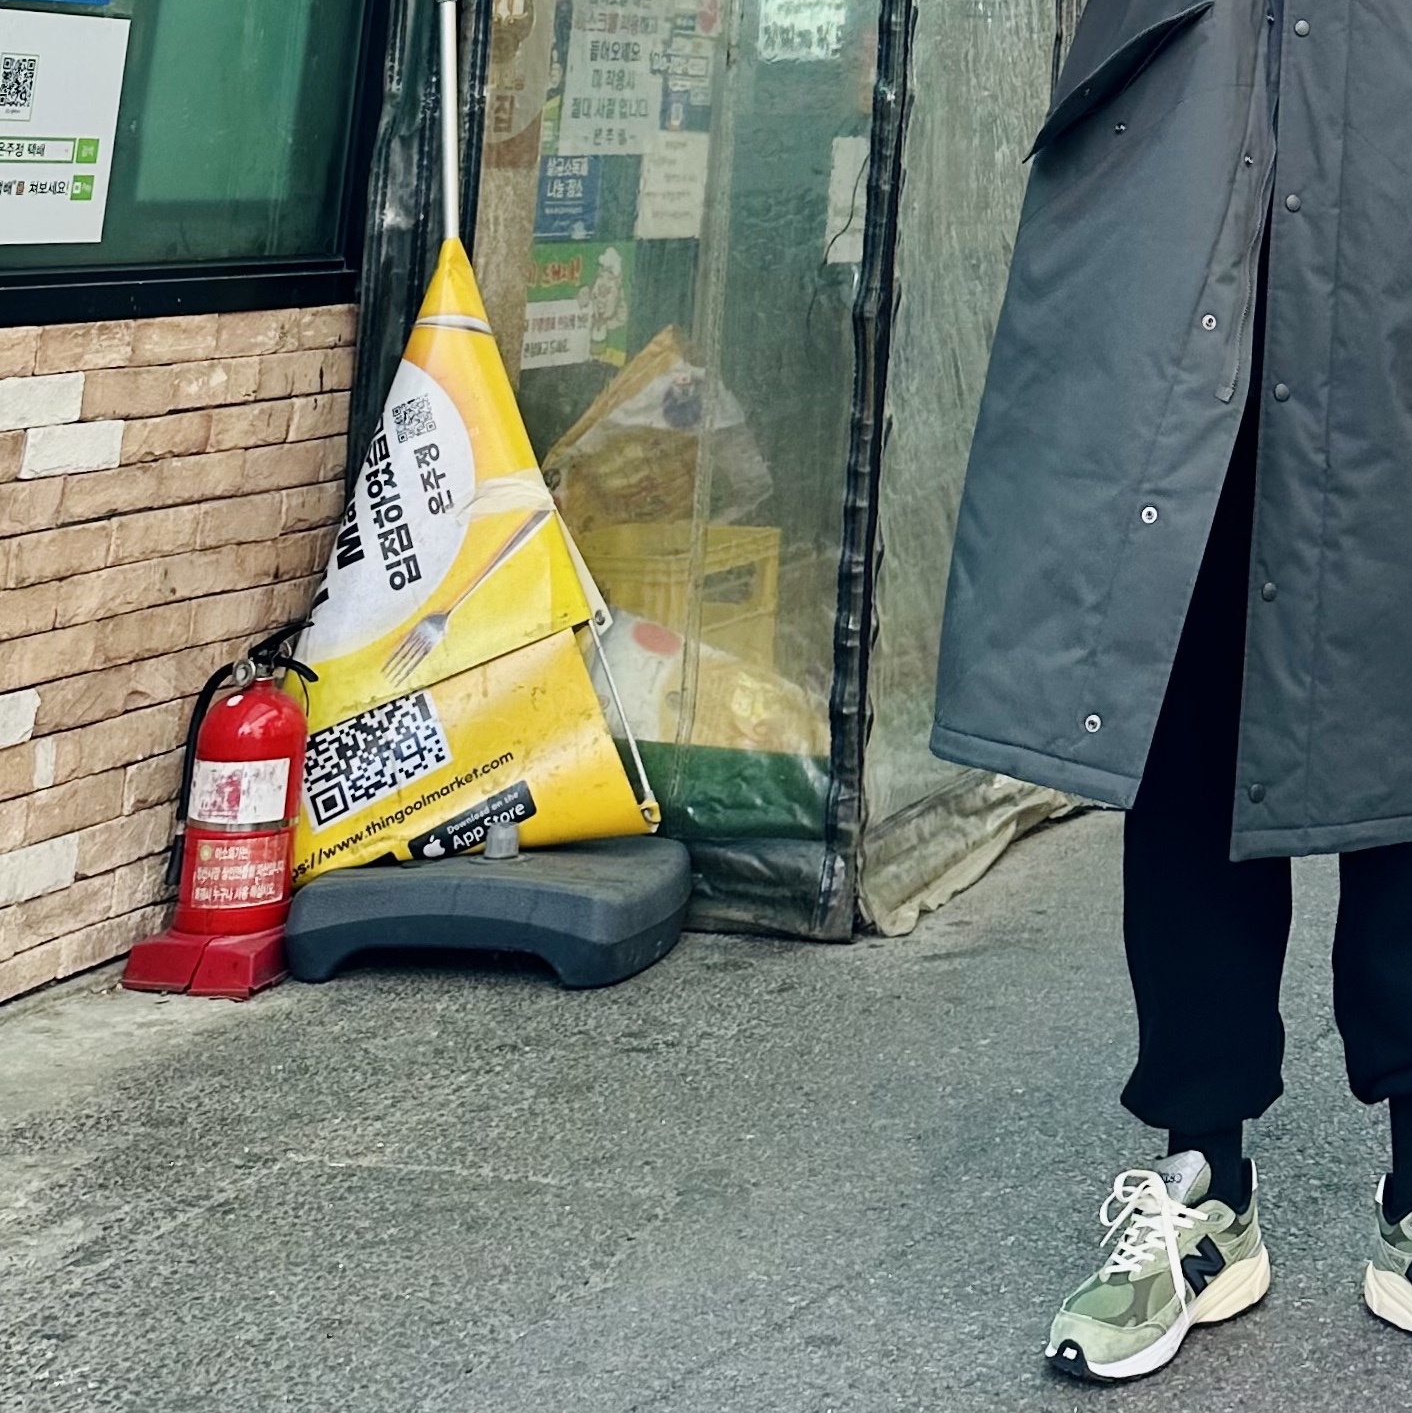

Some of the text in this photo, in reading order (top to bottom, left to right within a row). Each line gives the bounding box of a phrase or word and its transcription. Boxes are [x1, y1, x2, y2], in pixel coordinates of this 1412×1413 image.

[413, 443, 455, 515] 은주정
[336, 491, 366, 571] Ma
[446, 791, 520, 835] Download on the
[452, 824, 484, 851] App
